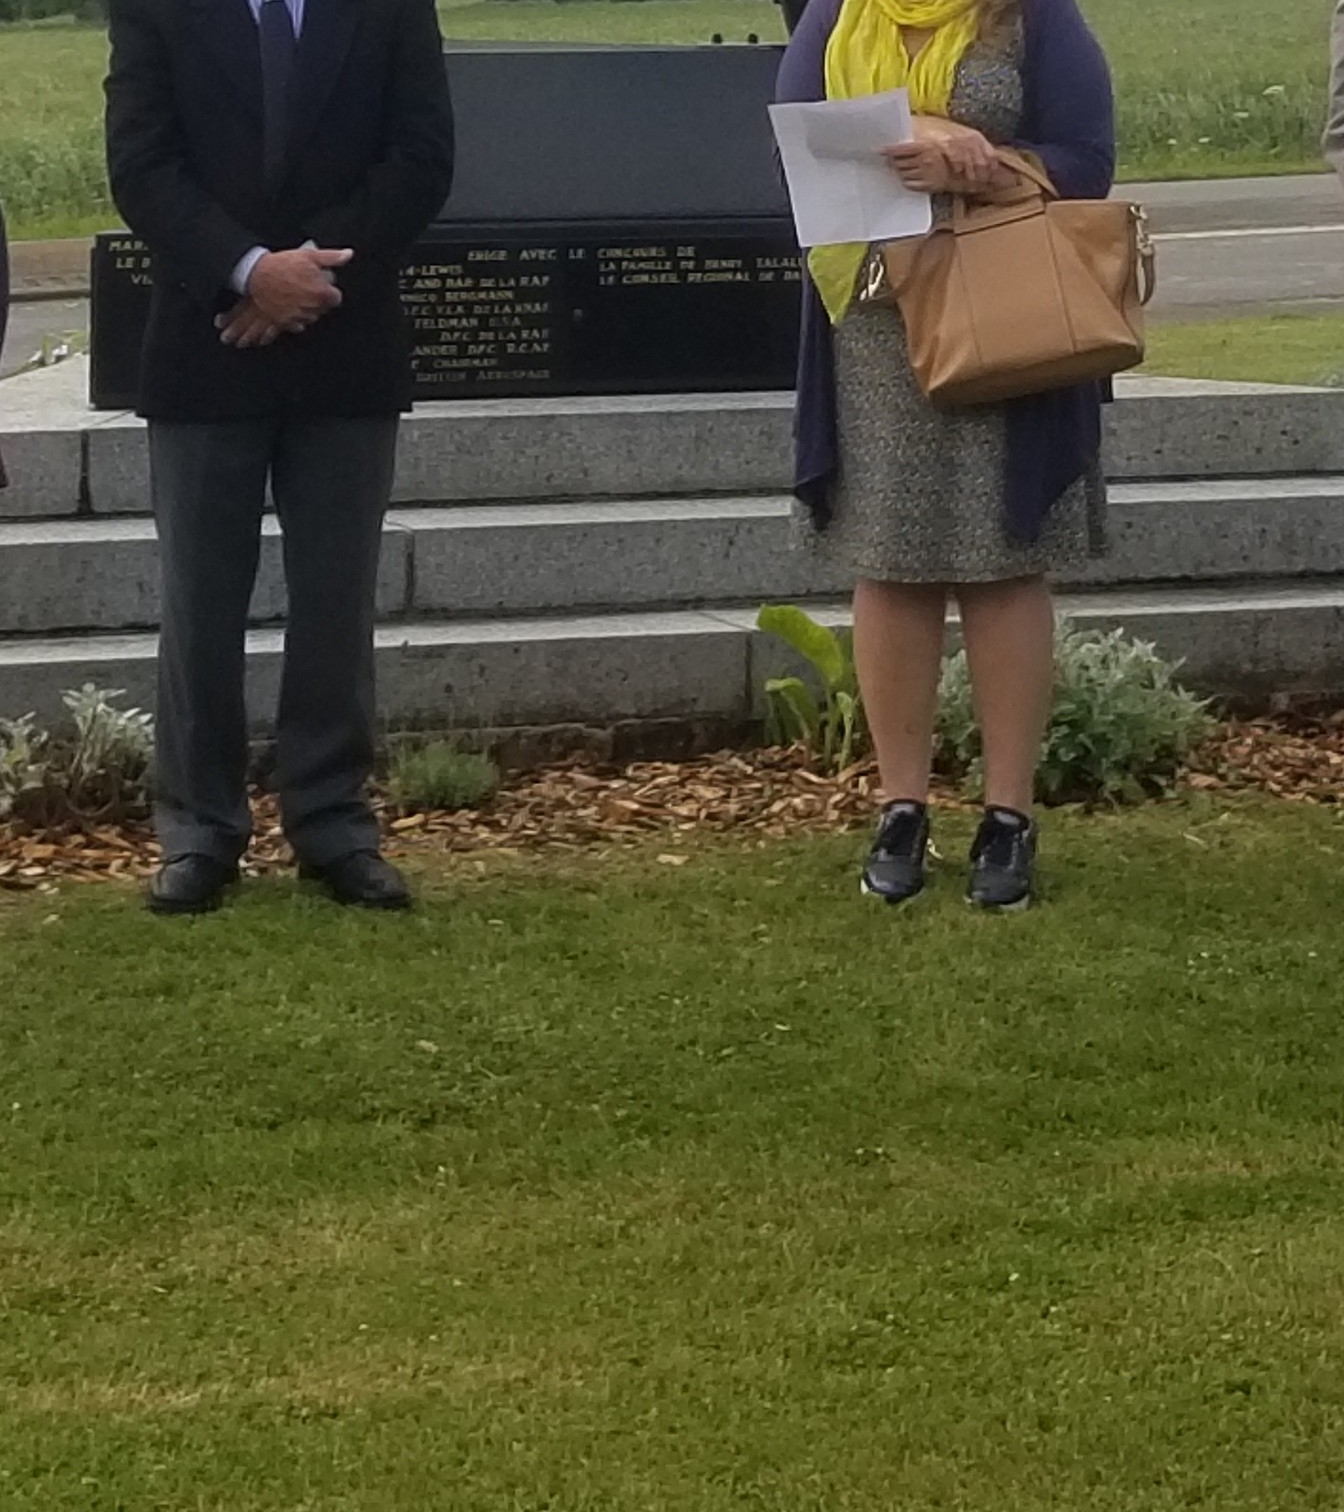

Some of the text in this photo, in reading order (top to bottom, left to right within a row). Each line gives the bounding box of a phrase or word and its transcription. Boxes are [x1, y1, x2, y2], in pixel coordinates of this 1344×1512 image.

[518, 248, 557, 261] AVEC
[567, 248, 586, 260] LE
[597, 247, 666, 259] CONCOURS
[676, 246, 696, 258] DE
[621, 261, 672, 271] FAMILLE
[622, 273, 681, 285] CONSEIL
